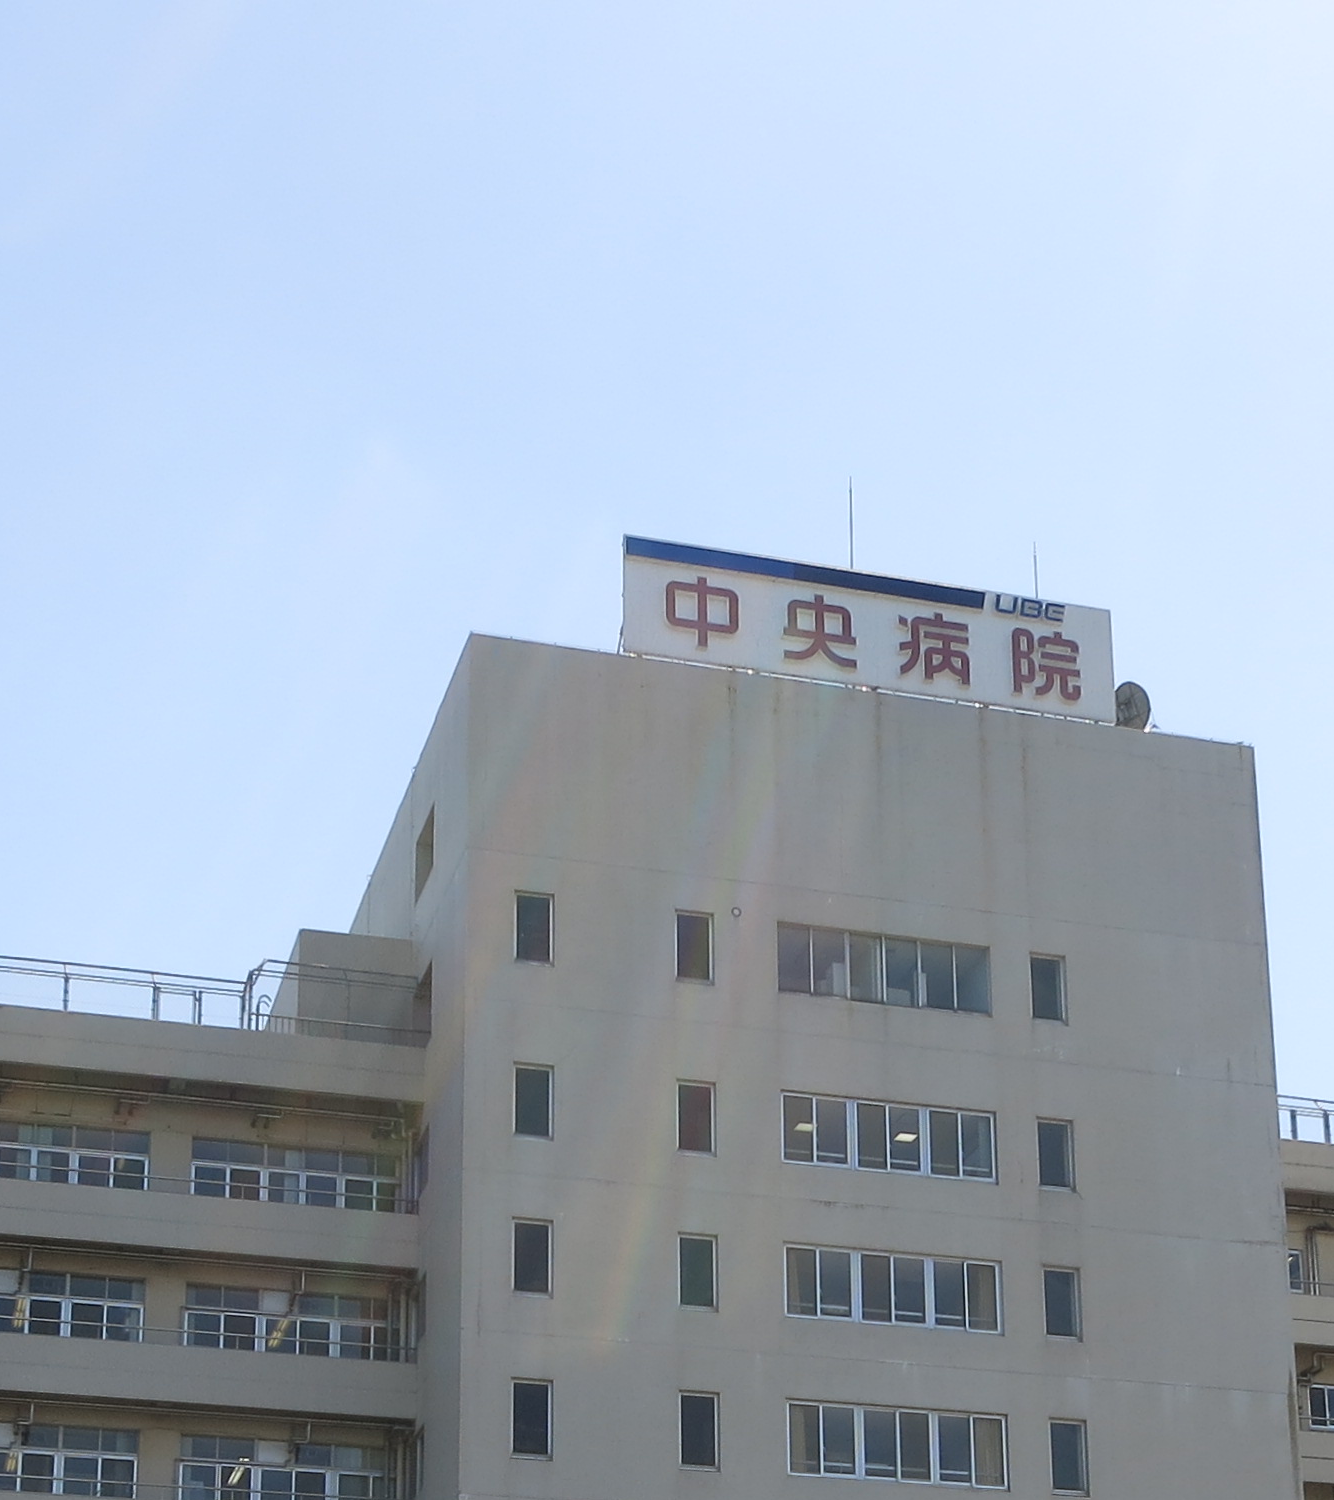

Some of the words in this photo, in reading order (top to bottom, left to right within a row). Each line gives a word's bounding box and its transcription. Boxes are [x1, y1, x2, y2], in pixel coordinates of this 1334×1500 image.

[665, 576, 1082, 701] 中央病院
[995, 594, 1065, 622] UBE
